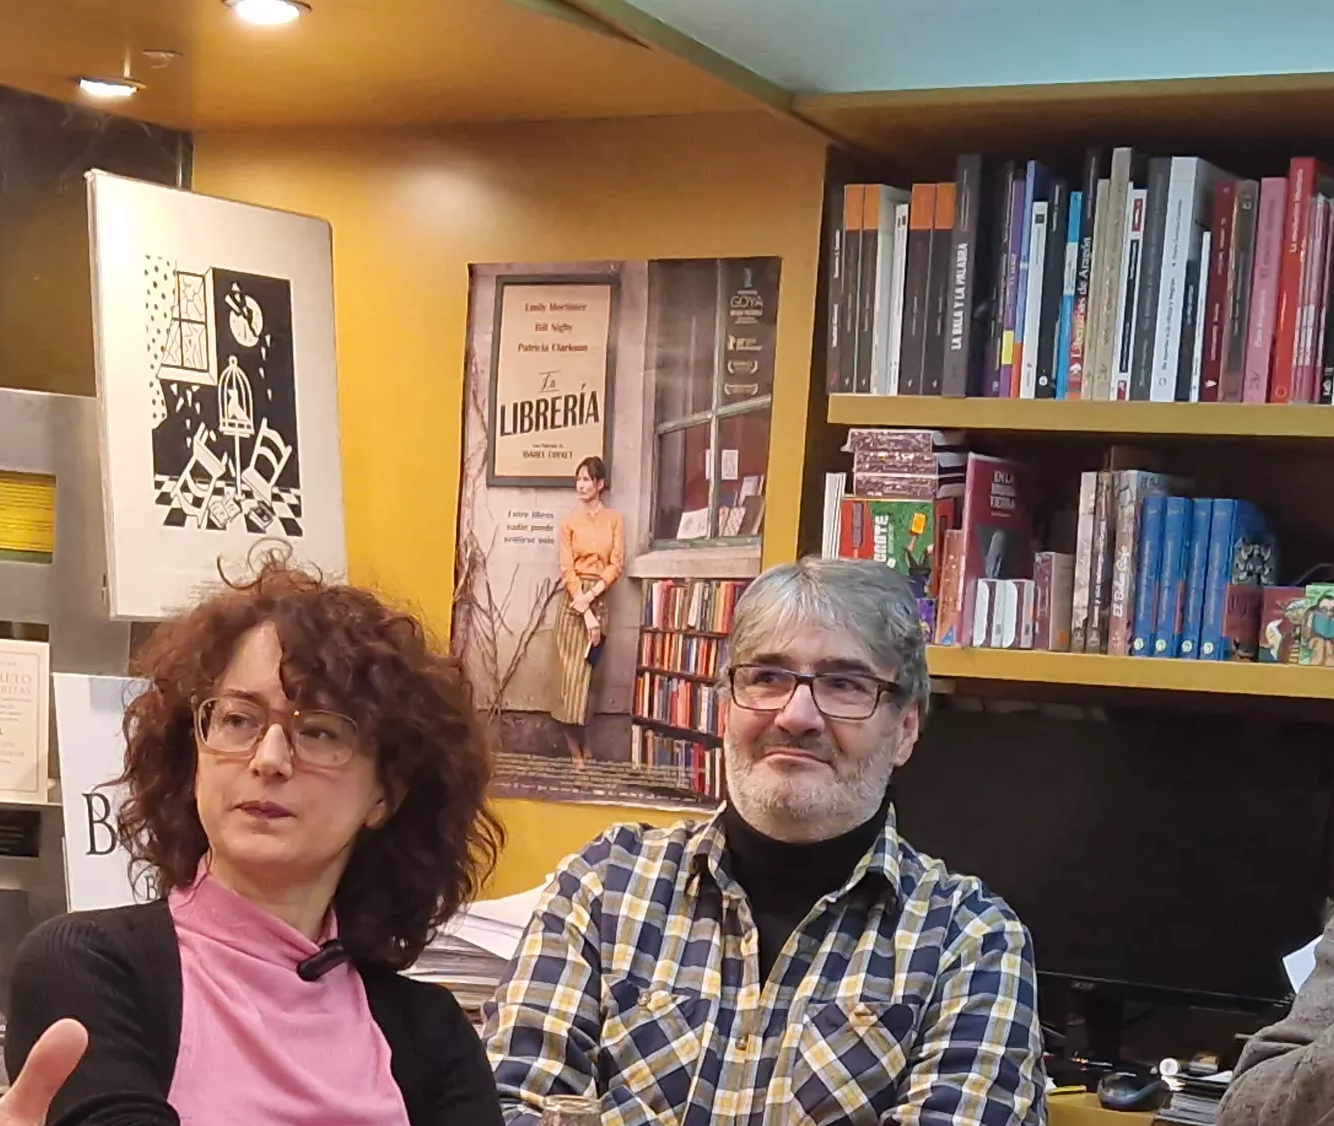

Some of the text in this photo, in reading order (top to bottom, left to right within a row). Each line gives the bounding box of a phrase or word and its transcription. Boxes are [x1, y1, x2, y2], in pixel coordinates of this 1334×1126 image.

[1078, 236, 1091, 278] Aragón
[730, 296, 763, 308] GOYA
[517, 343, 549, 353] Patricia
[951, 336, 963, 350] LA
[499, 383, 600, 437] LIBRERÍA
